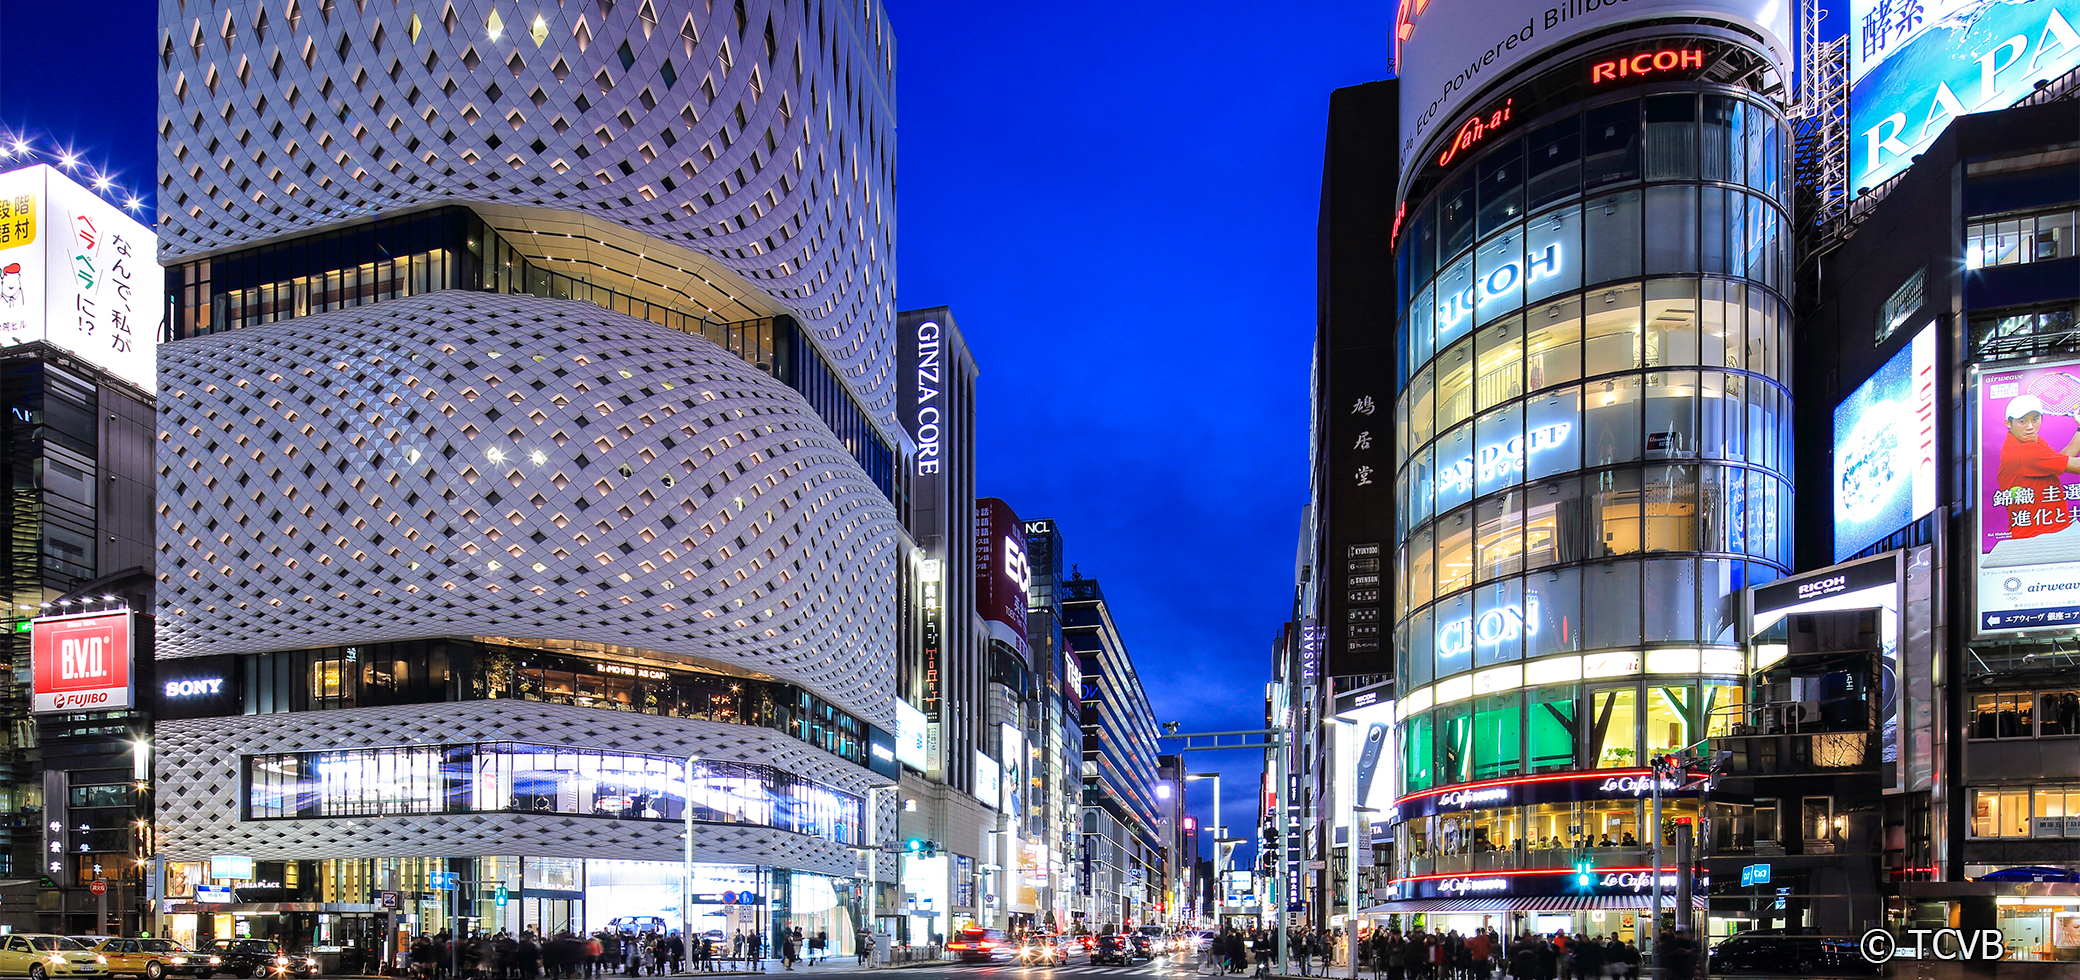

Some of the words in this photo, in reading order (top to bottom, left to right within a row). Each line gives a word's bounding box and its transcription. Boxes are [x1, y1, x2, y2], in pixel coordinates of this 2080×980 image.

[1416, 17, 1535, 137] Eco-Powered
[1544, 0, 1633, 31] Billbo
[1593, 49, 1703, 84] RICOH
[1440, 97, 1513, 167] San-ai
[111, 233, 132, 354] なんで、私が
[917, 321, 940, 404] GINZA
[1985, 373, 2025, 384] airweave
[917, 406, 940, 477] CORE
[1350, 394, 1376, 487] 鳩居堂
[1507, 423, 1568, 455] OFF
[1992, 488, 2035, 507] 錦織
[1025, 521, 1051, 534] NCL
[1798, 575, 1846, 594] RICOH
[2004, 613, 2045, 623] エアウィーヴ
[61, 636, 107, 680] B.V.D.
[1303, 624, 1315, 679] TASAKI
[166, 678, 223, 697] SONY
[67, 692, 109, 708] FUJIBO
[1600, 778, 1618, 791] Le
[1617, 775, 1651, 795] Café
[1438, 792, 1452, 806] Le
[1450, 788, 1473, 808] Café
[257, 880, 281, 889] PLACE
[1437, 879, 1451, 891] Le
[1450, 877, 1473, 896] Café
[1600, 873, 1619, 886] Le
[1618, 872, 1651, 892] Café
